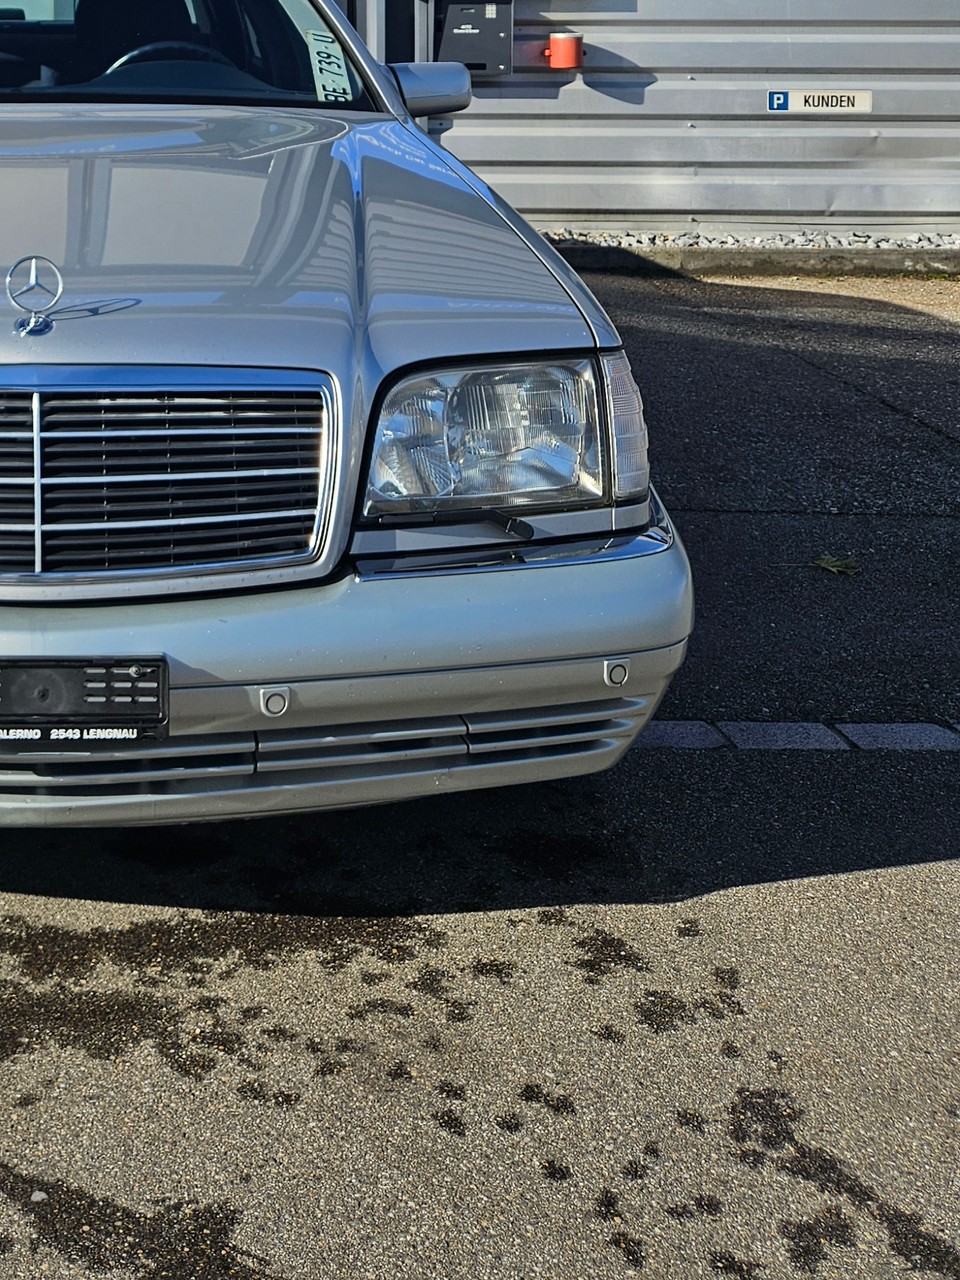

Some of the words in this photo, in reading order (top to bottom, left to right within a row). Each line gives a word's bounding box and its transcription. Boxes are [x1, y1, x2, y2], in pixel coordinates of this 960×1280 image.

[773, 93, 784, 109] P
[803, 95, 855, 108] KUNDEN
[50, 728, 80, 740] 2543
[82, 728, 138, 740] LENGNAU
